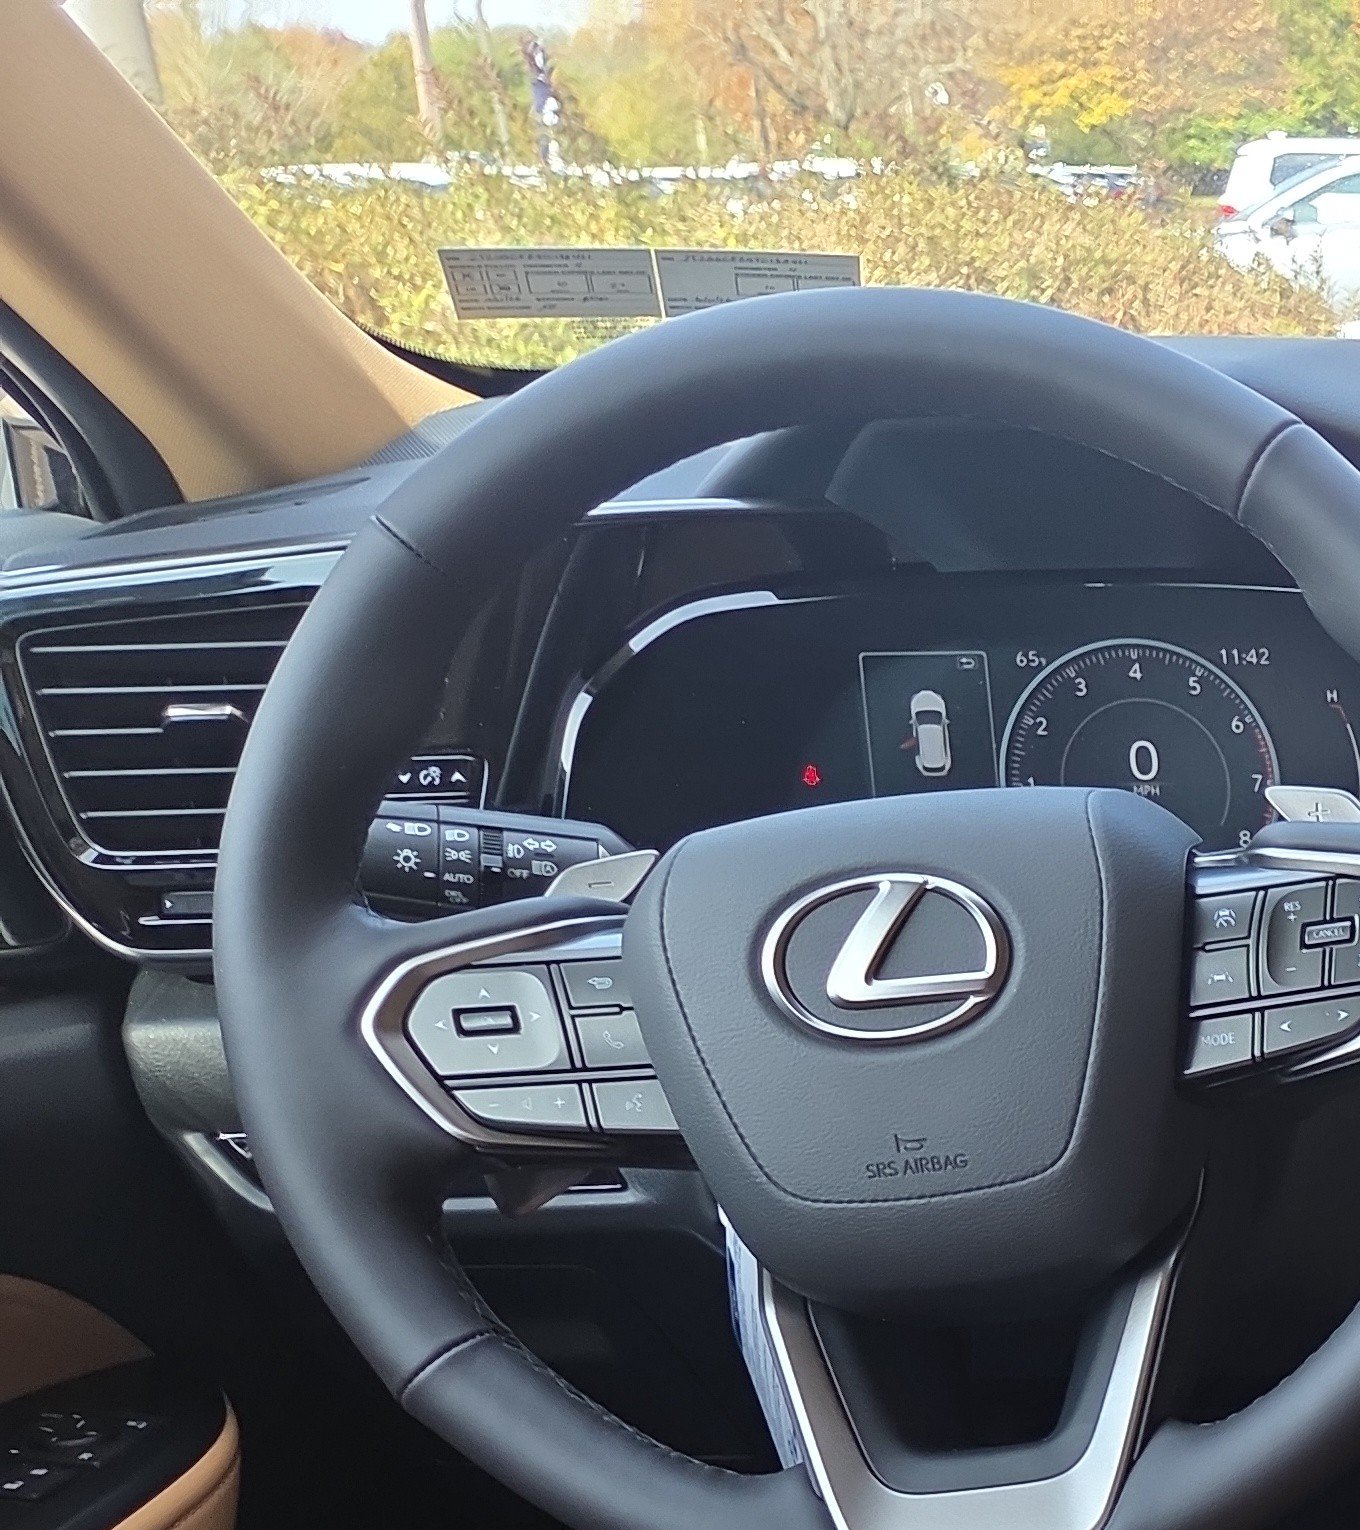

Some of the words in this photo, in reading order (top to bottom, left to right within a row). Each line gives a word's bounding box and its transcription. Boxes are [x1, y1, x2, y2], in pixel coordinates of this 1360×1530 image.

[1219, 647, 1270, 665] 11:42
[1128, 662, 1143, 682] 4
[1074, 677, 1088, 697] 3
[1188, 676, 1202, 695] 5
[1326, 689, 1338, 703] H
[1035, 716, 1049, 736] 2
[1231, 715, 1245, 734] 6
[1129, 740, 1159, 781] 0
[1133, 784, 1160, 796] MPH
[1251, 773, 1263, 792] 7
[1239, 829, 1251, 847] 8
[443, 872, 475, 884] AUTO
[1312, 928, 1347, 938] CANCEL
[1201, 1032, 1236, 1046] MODE
[866, 1160, 899, 1179] SRS
[903, 1153, 968, 1175] AIRBAG
